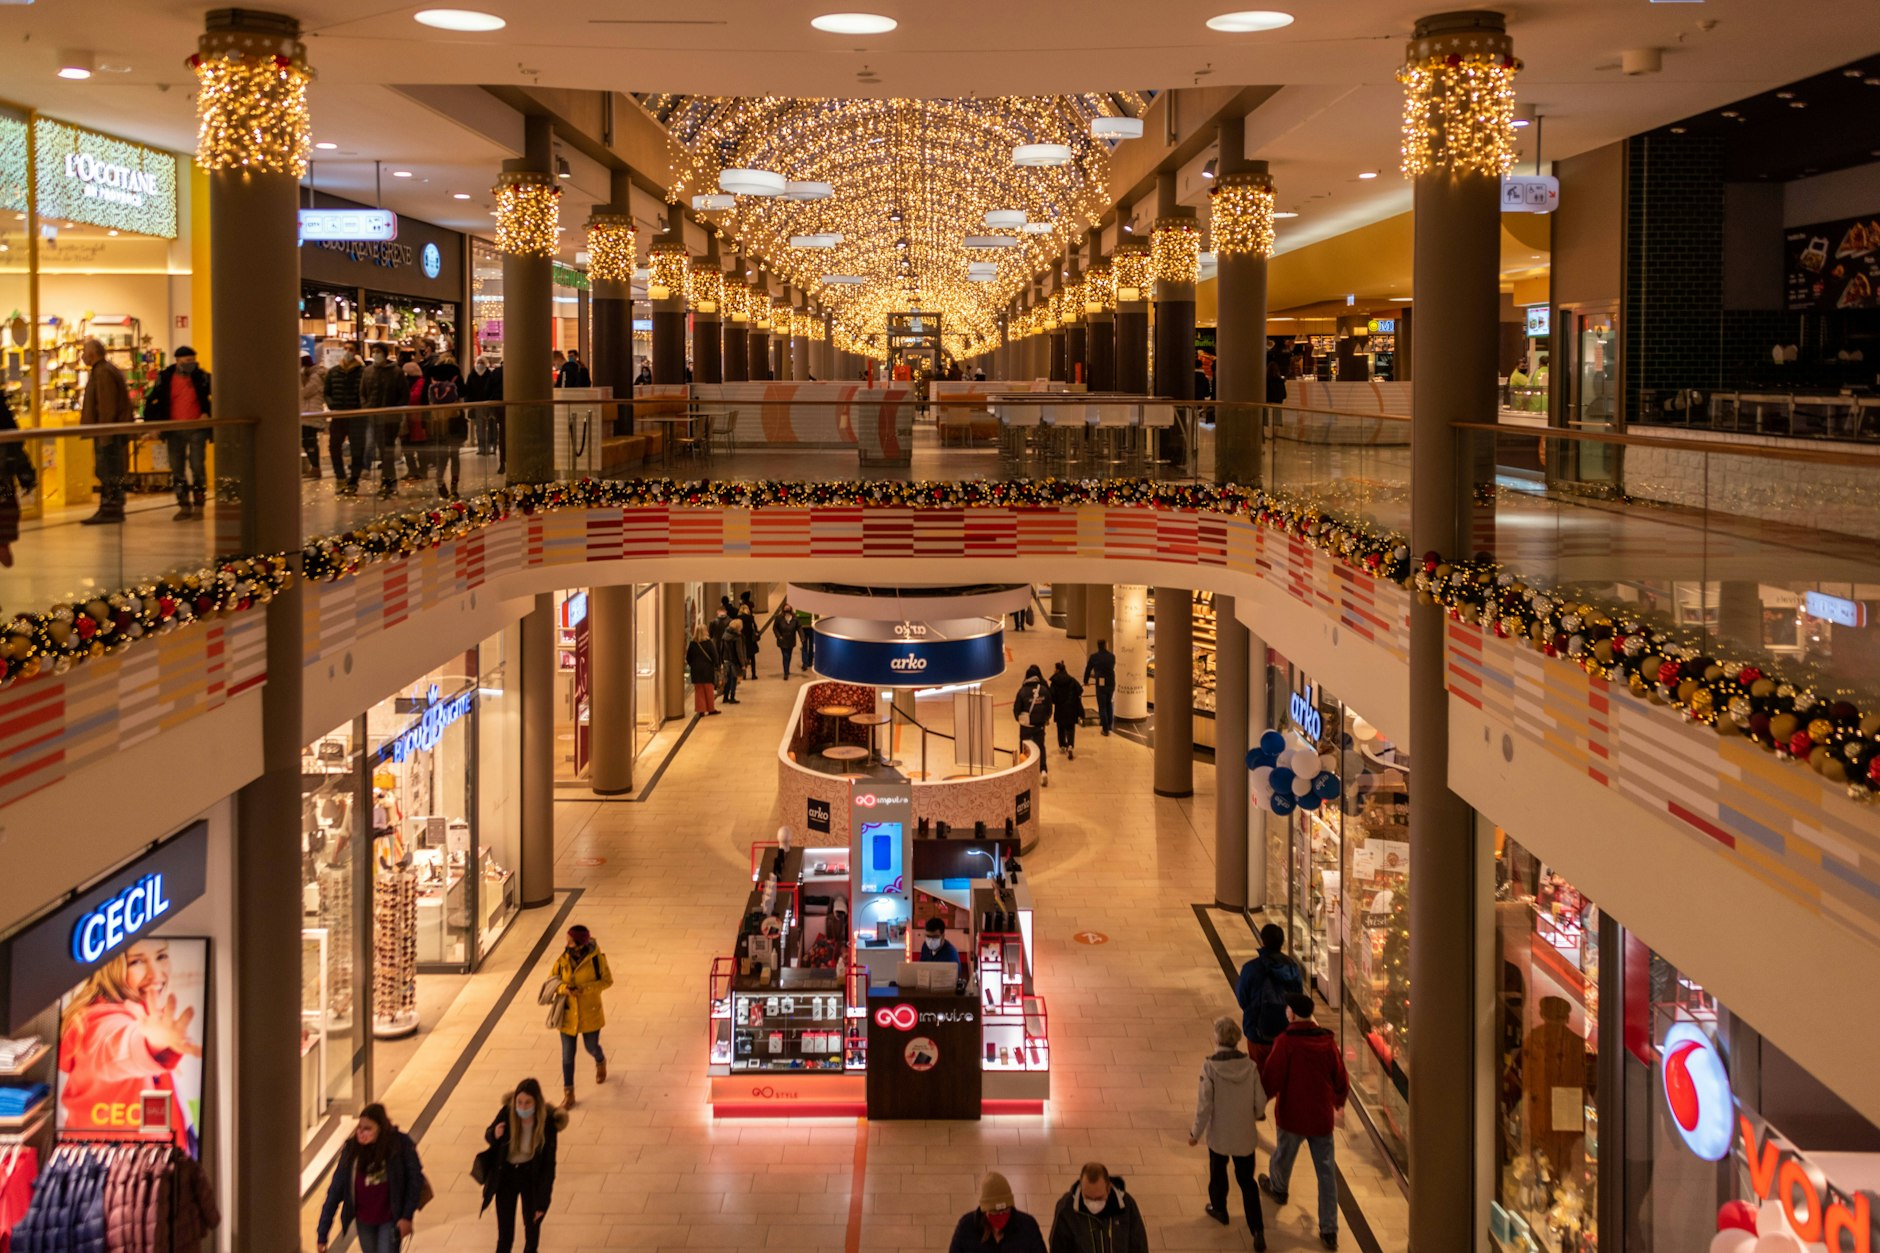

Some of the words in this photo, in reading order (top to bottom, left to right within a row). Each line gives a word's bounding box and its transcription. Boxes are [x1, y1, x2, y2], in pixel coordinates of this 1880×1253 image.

[64, 153, 158, 196] L'OCCITANE
[890, 652, 928, 670] arko
[1291, 684, 1321, 742] arko
[877, 796, 909, 805] impulse
[808, 806, 829, 821] arko
[72, 873, 169, 963] CECIL
[919, 1008, 974, 1026] impulse
